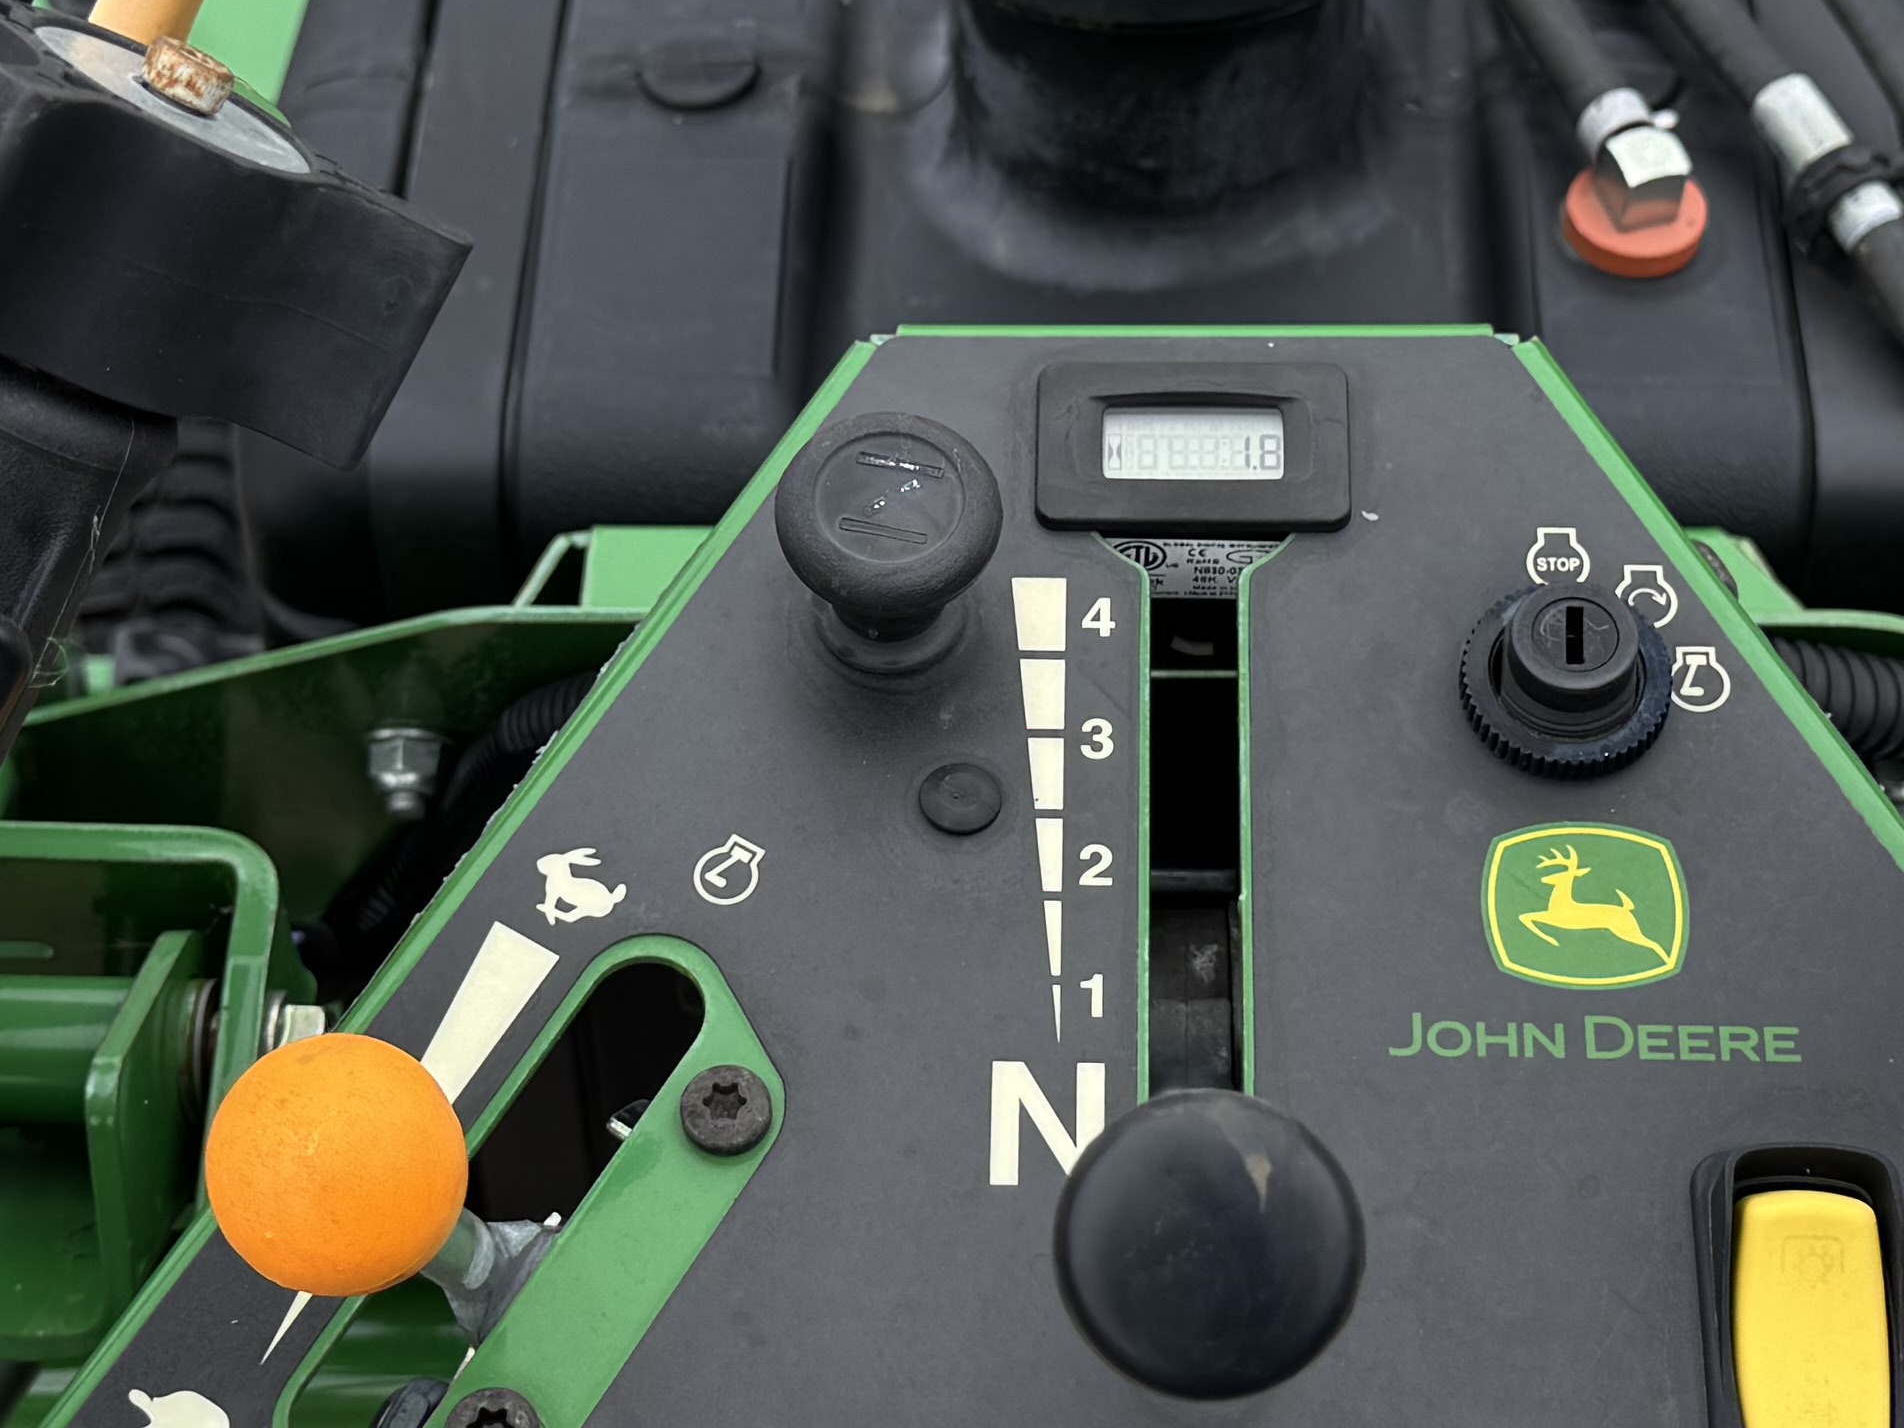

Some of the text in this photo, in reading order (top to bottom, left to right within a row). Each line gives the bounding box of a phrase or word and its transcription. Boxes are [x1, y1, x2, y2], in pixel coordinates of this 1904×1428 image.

[1537, 557, 1581, 574] STOP
[1081, 598, 1115, 637] 4
[1080, 719, 1114, 760] 3
[1078, 844, 1113, 886] 2
[1079, 973, 1105, 1018] 1
[1389, 1012, 1802, 1063] JOHN DEERE
[990, 1060, 1106, 1185] N
